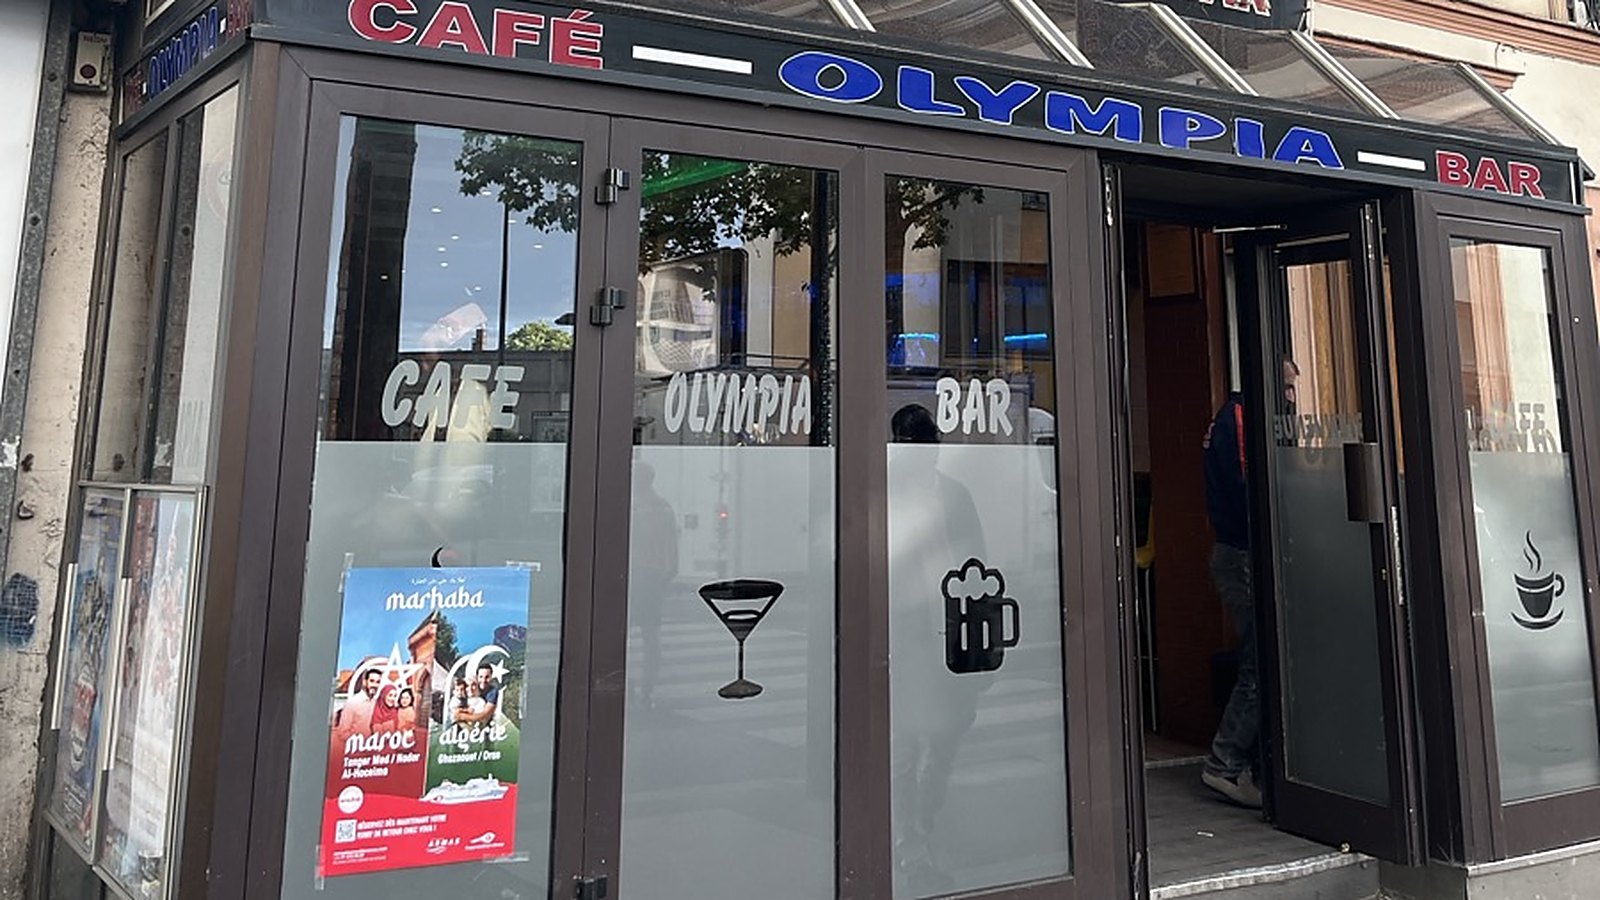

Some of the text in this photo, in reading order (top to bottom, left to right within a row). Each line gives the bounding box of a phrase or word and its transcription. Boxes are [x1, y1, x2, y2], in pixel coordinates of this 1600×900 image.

[348, 0, 1546, 199] CAFÉ OLYMPIA BAR
[381, 358, 525, 429] CAFE
[664, 371, 811, 435] OLYMPIA
[936, 377, 1013, 436] BAR
[385, 585, 485, 611] marhaba
[345, 729, 416, 754] maroc
[439, 721, 508, 752] algérie
